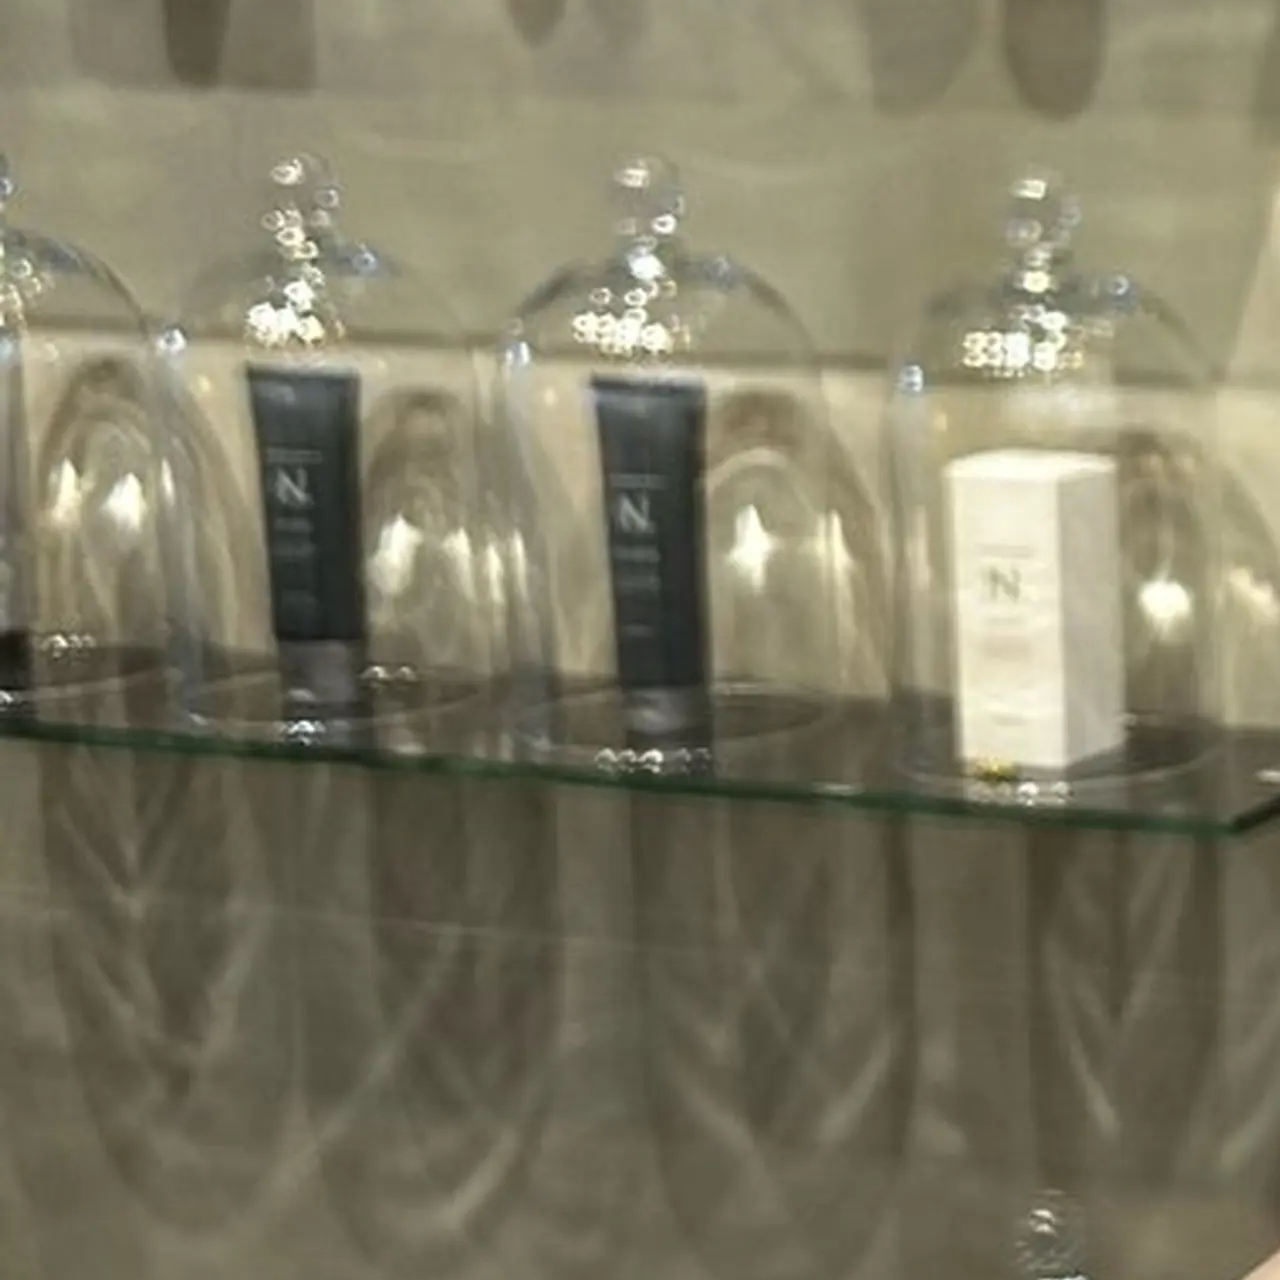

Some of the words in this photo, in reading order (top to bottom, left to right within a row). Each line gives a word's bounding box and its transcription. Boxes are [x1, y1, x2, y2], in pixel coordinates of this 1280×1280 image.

[274, 468, 313, 507] N
[618, 492, 655, 531] N
[984, 566, 1022, 602] N
